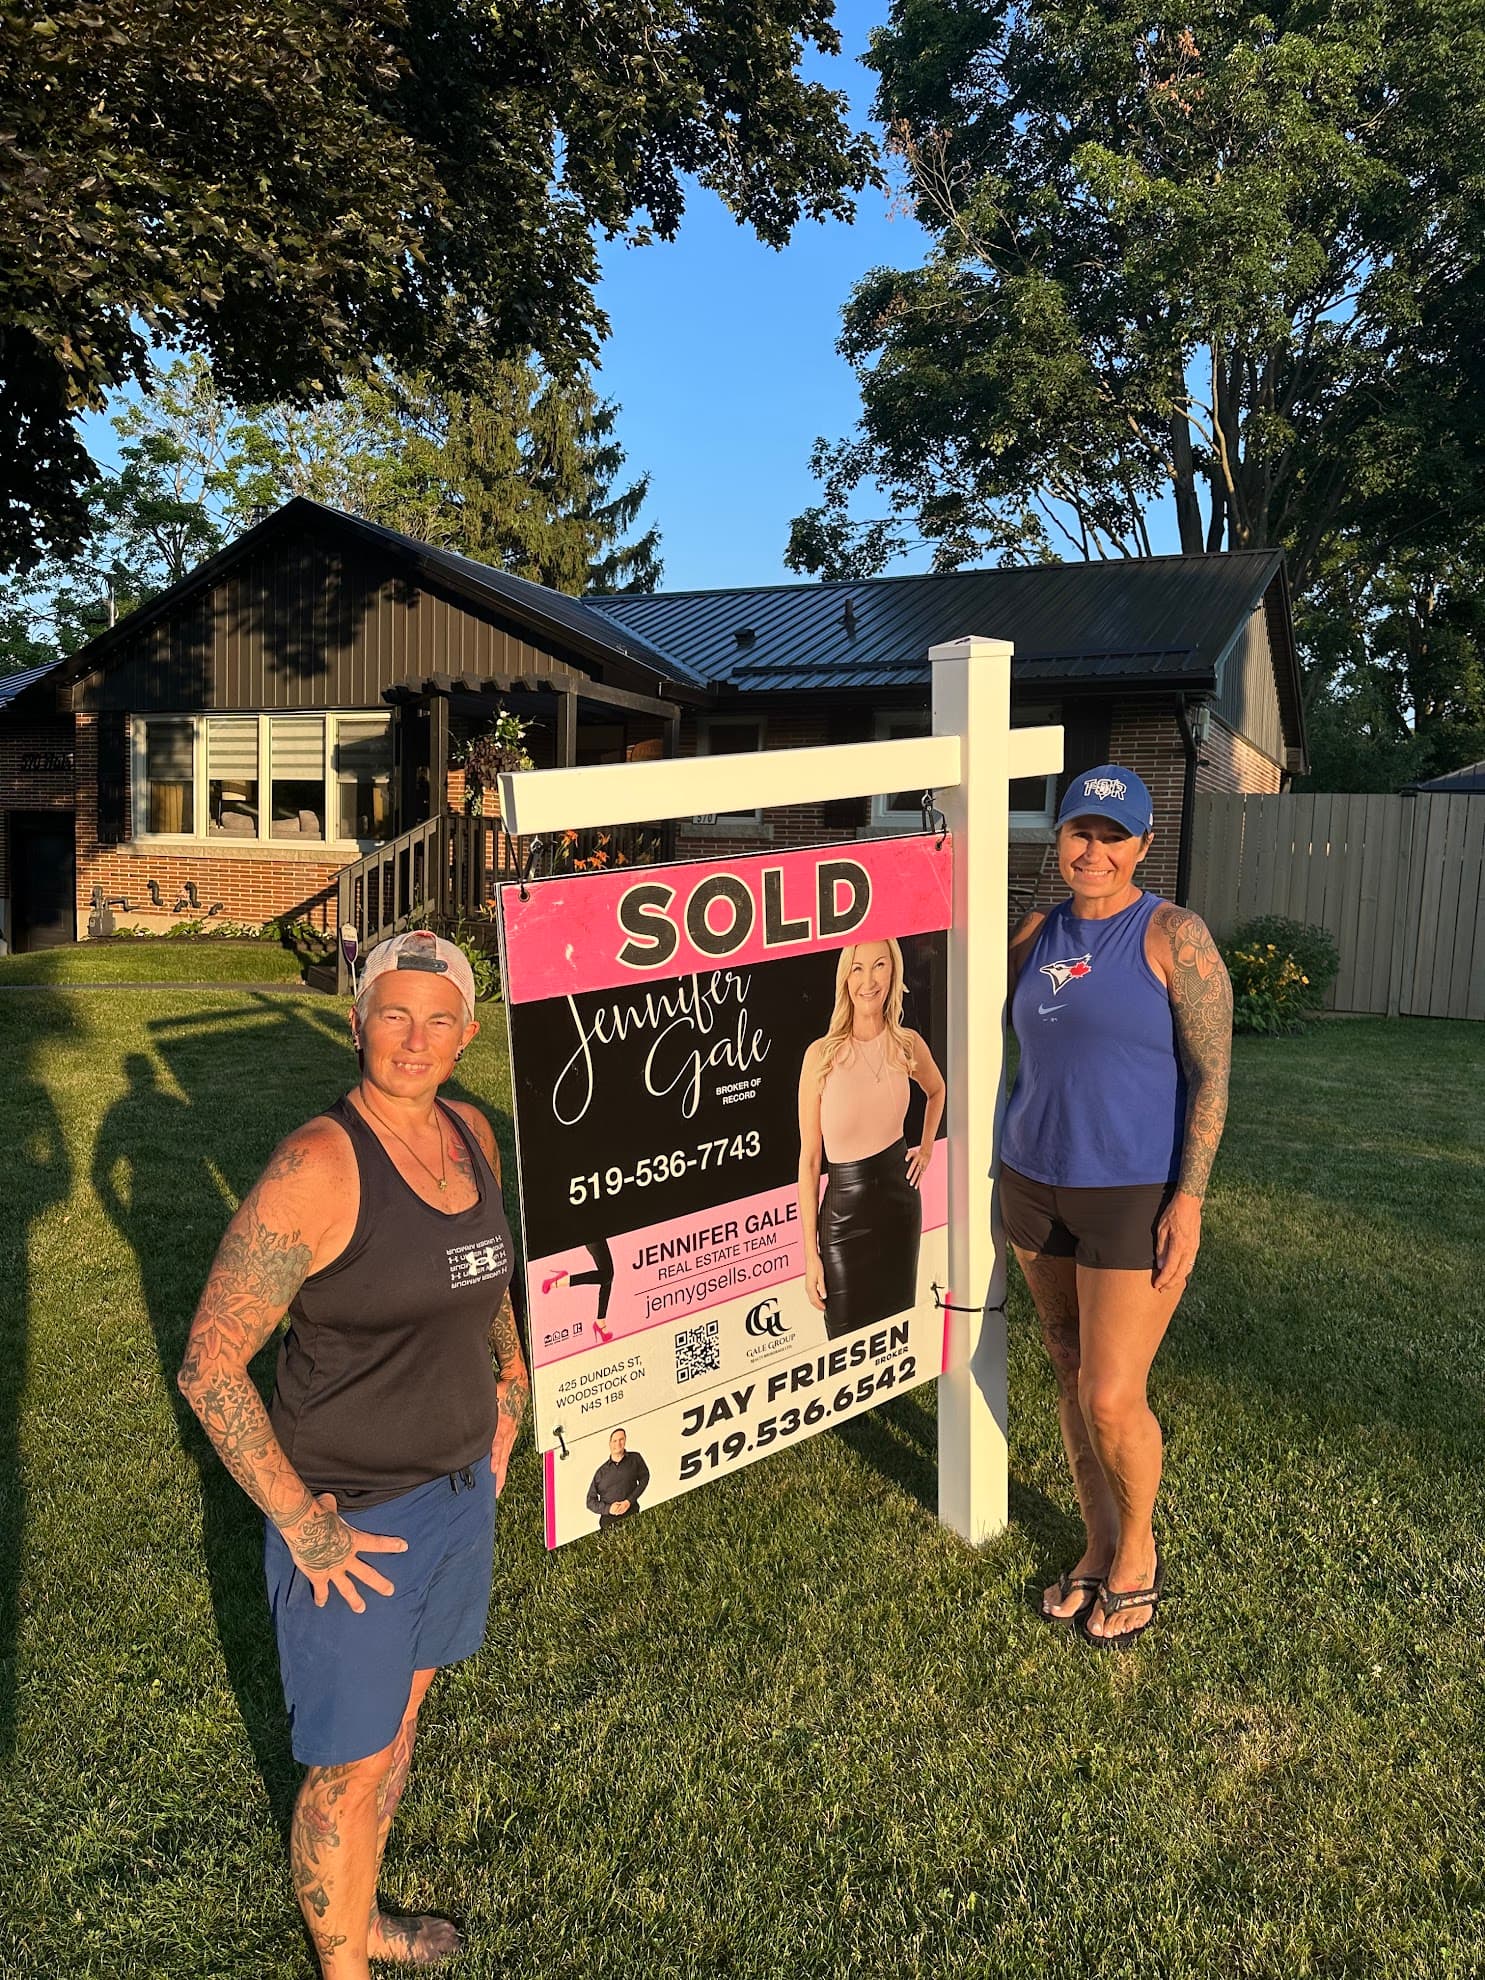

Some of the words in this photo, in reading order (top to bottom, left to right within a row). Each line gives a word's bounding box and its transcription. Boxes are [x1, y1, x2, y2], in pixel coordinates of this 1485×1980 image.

[615, 858, 873, 970] SOLD
[553, 970, 752, 1125] Jennifer
[644, 1008, 772, 1119] Gale
[715, 1080, 749, 1096] BROKER
[750, 1078, 762, 1087] OF
[722, 1090, 756, 1105] RECORD
[568, 1130, 762, 1206] 519-536-7743
[632, 1221, 739, 1270] JENNIFER
[745, 1202, 798, 1234] GALE
[658, 1260, 692, 1281] REAL
[696, 1244, 741, 1269] ESTATE
[743, 1232, 777, 1253] TEAM
[645, 1254, 789, 1319] jennygsells.com
[746, 1343, 767, 1358] GALE
[767, 1333, 796, 1350] GROUP
[875, 1346, 909, 1366] BROKER
[556, 1374, 628, 1409] WOODSTOCK
[630, 1368, 646, 1381] ON
[558, 1379, 577, 1393] 425
[580, 1361, 625, 1386] DUNDAS
[581, 1398, 602, 1414] N4S
[605, 1390, 624, 1405] 1B8
[681, 1384, 756, 1437] JAY
[768, 1320, 909, 1403] FRIESEN
[679, 1356, 917, 1481] 519.536.6542
